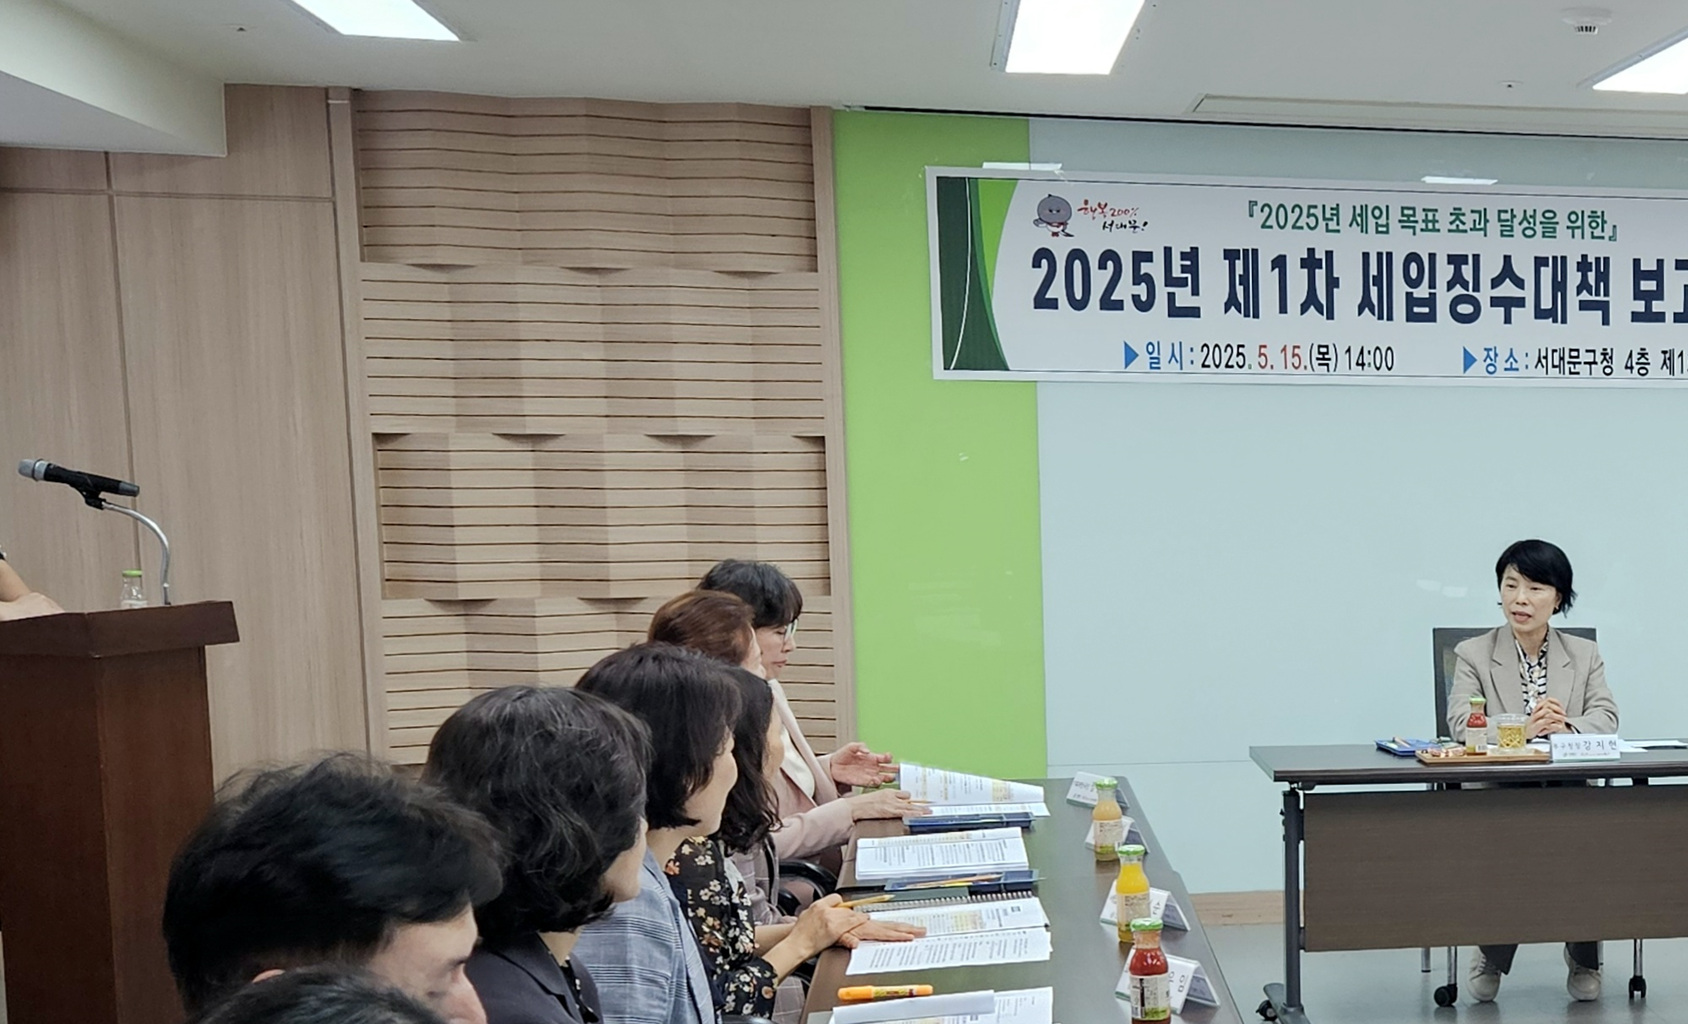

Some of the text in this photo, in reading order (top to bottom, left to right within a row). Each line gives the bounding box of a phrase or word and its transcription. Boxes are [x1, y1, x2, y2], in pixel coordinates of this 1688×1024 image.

[1349, 204, 1390, 235] 세입
[1398, 206, 1441, 237] 목표
[1448, 207, 1490, 237] 초과
[1499, 208, 1560, 239] 달성을
[1031, 246, 1201, 319] 2025년
[1223, 247, 1340, 321] 제1차
[1358, 250, 1611, 327] 세입징수대책
[1344, 345, 1395, 373] 14:00
[1535, 347, 1614, 376] 서대문구청
[1624, 349, 1651, 376] 4층
